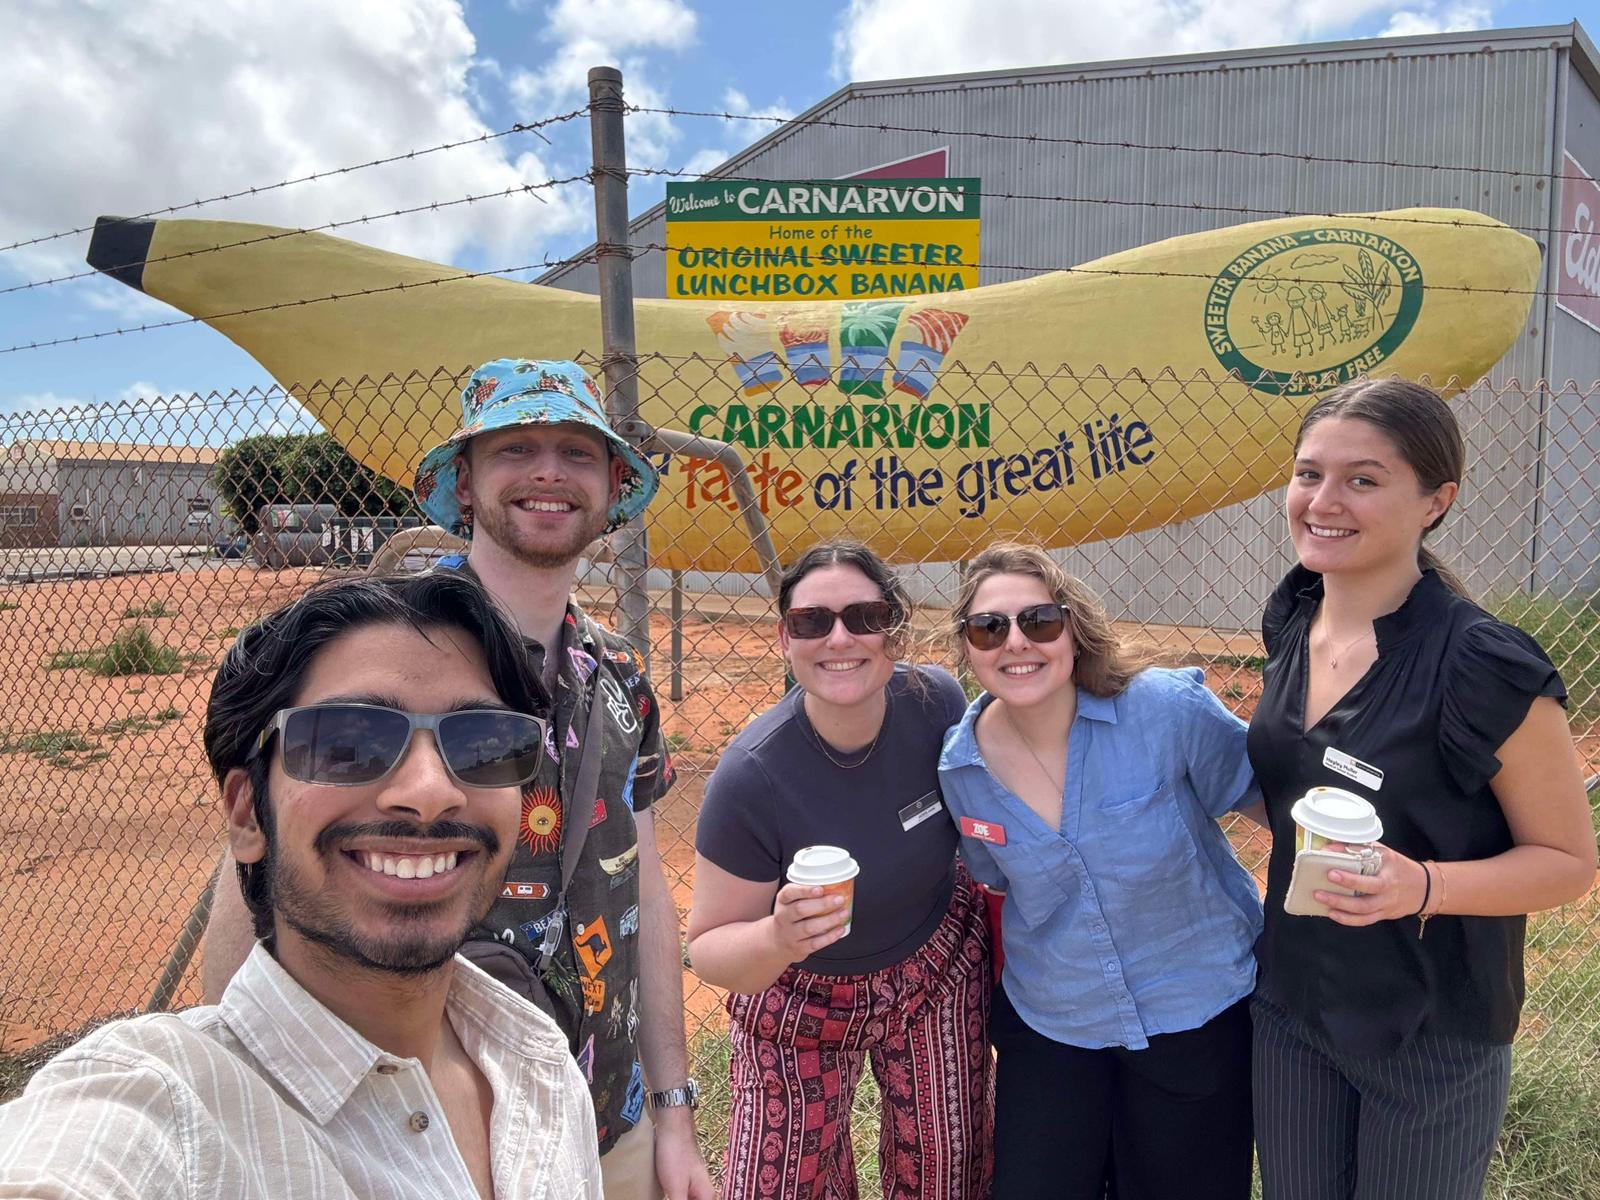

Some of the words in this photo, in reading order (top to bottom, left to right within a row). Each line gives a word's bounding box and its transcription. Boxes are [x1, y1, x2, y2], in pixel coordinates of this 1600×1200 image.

[670, 190, 721, 214] Welcome
[724, 189, 737, 204] to
[738, 186, 965, 214] CARNARVON
[769, 225, 814, 240] Home
[820, 224, 838, 239] of
[844, 224, 873, 239] the
[678, 243, 814, 269] ORIGINAL
[821, 243, 963, 267] SWEETER
[677, 273, 839, 296] LUNCHBOX
[851, 272, 965, 296] BANANA
[1208, 276, 1235, 356] SWEETER
[1230, 235, 1298, 279] BANANA
[1314, 229, 1420, 283] CARNARVON
[1346, 346, 1385, 379] FREE
[689, 403, 991, 449] CARNARVON
[814, 458, 857, 511] of
[871, 457, 944, 511] the
[956, 431, 1075, 519] great
[1088, 413, 1156, 480] life
